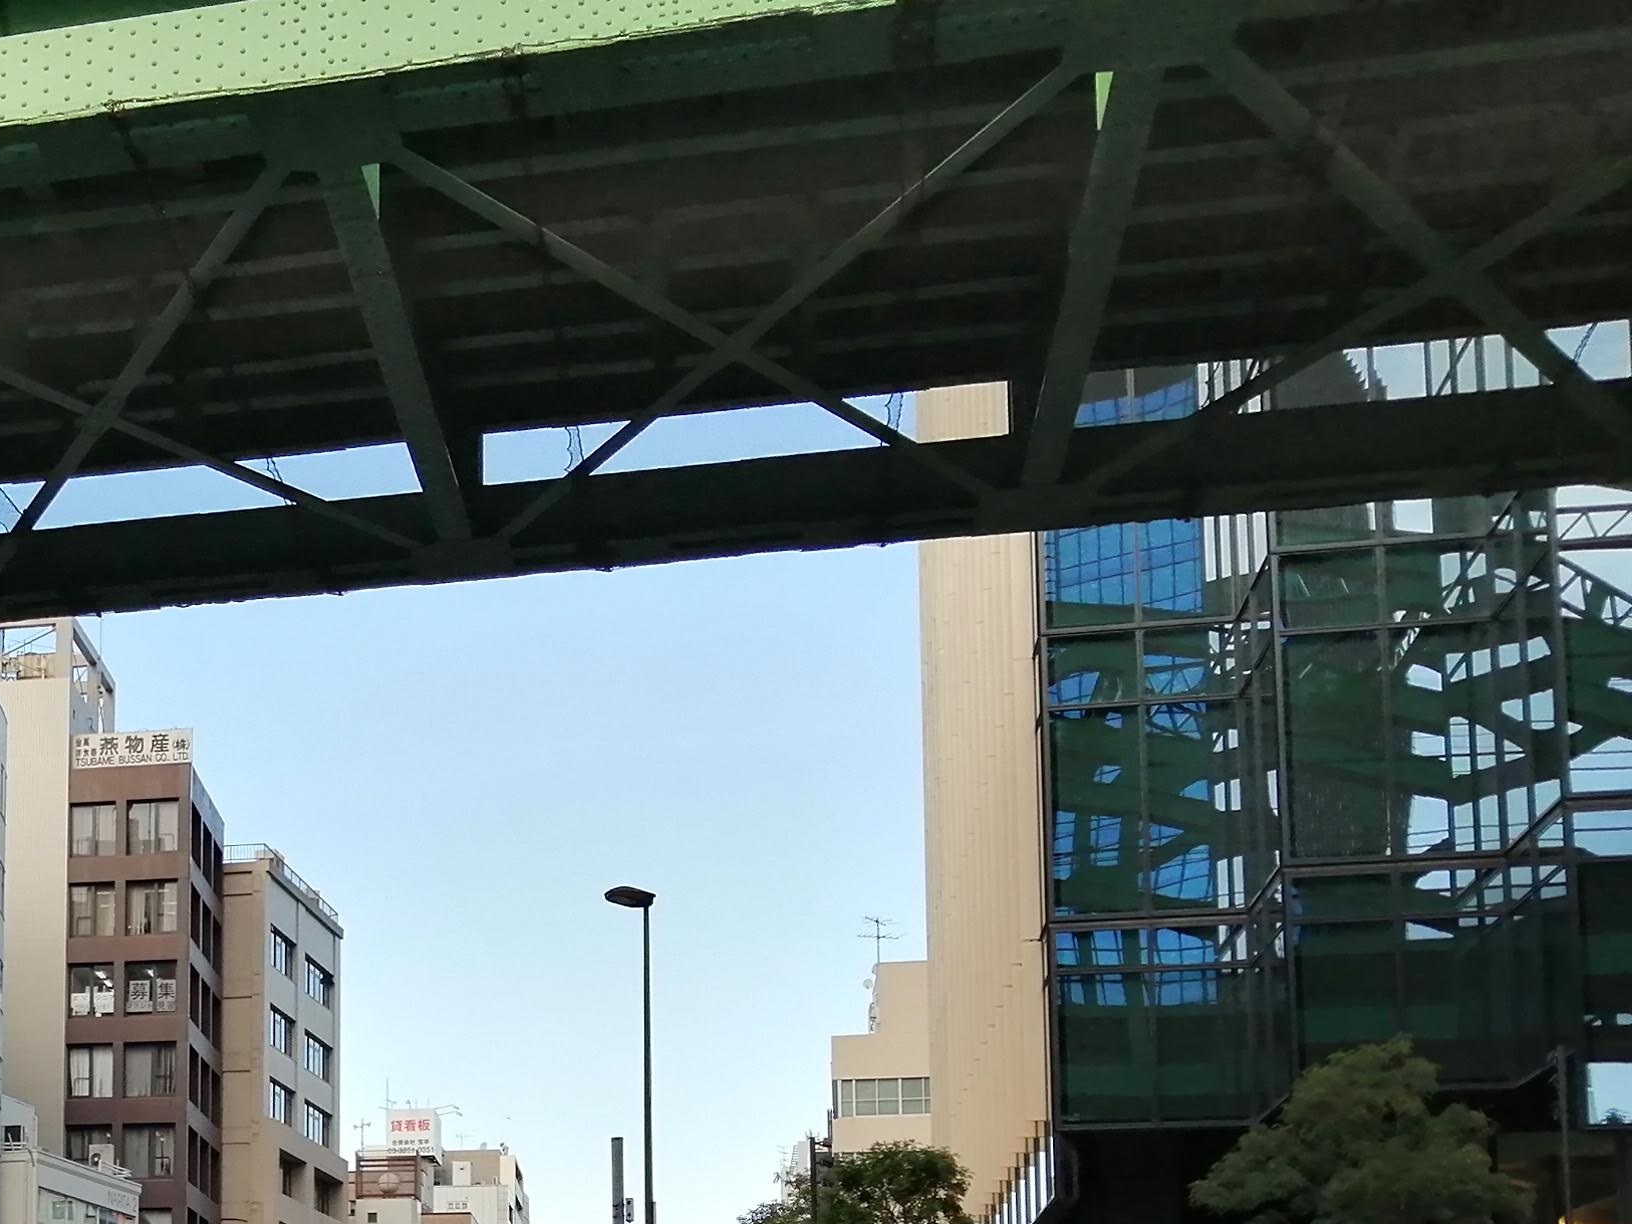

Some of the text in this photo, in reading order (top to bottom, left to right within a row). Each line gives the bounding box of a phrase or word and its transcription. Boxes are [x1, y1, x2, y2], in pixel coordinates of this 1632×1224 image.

[75, 757, 116, 767] TSUBAME
[118, 754, 153, 765] BUSSAN
[130, 982, 175, 1000] 募集
[391, 1119, 431, 1133] 貸看板
